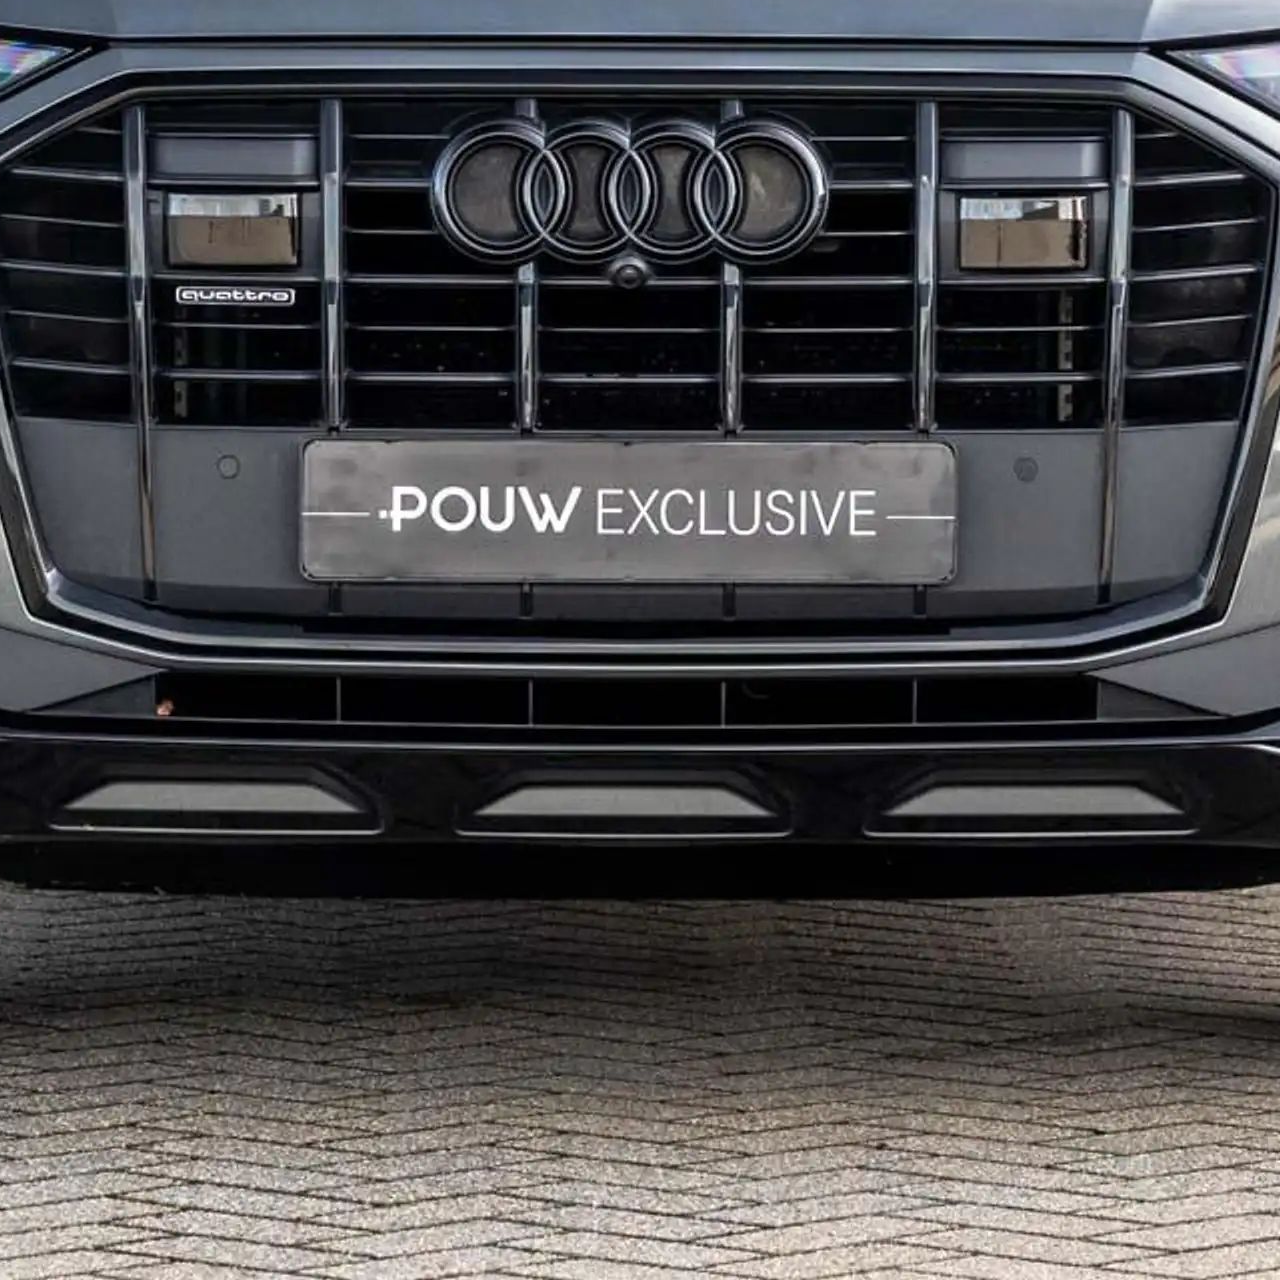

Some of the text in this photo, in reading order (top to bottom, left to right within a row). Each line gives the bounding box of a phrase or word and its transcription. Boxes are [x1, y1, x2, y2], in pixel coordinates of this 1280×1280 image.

[181, 289, 289, 302] quattro
[380, 485, 877, 536] POUW EXCLUSIVE
